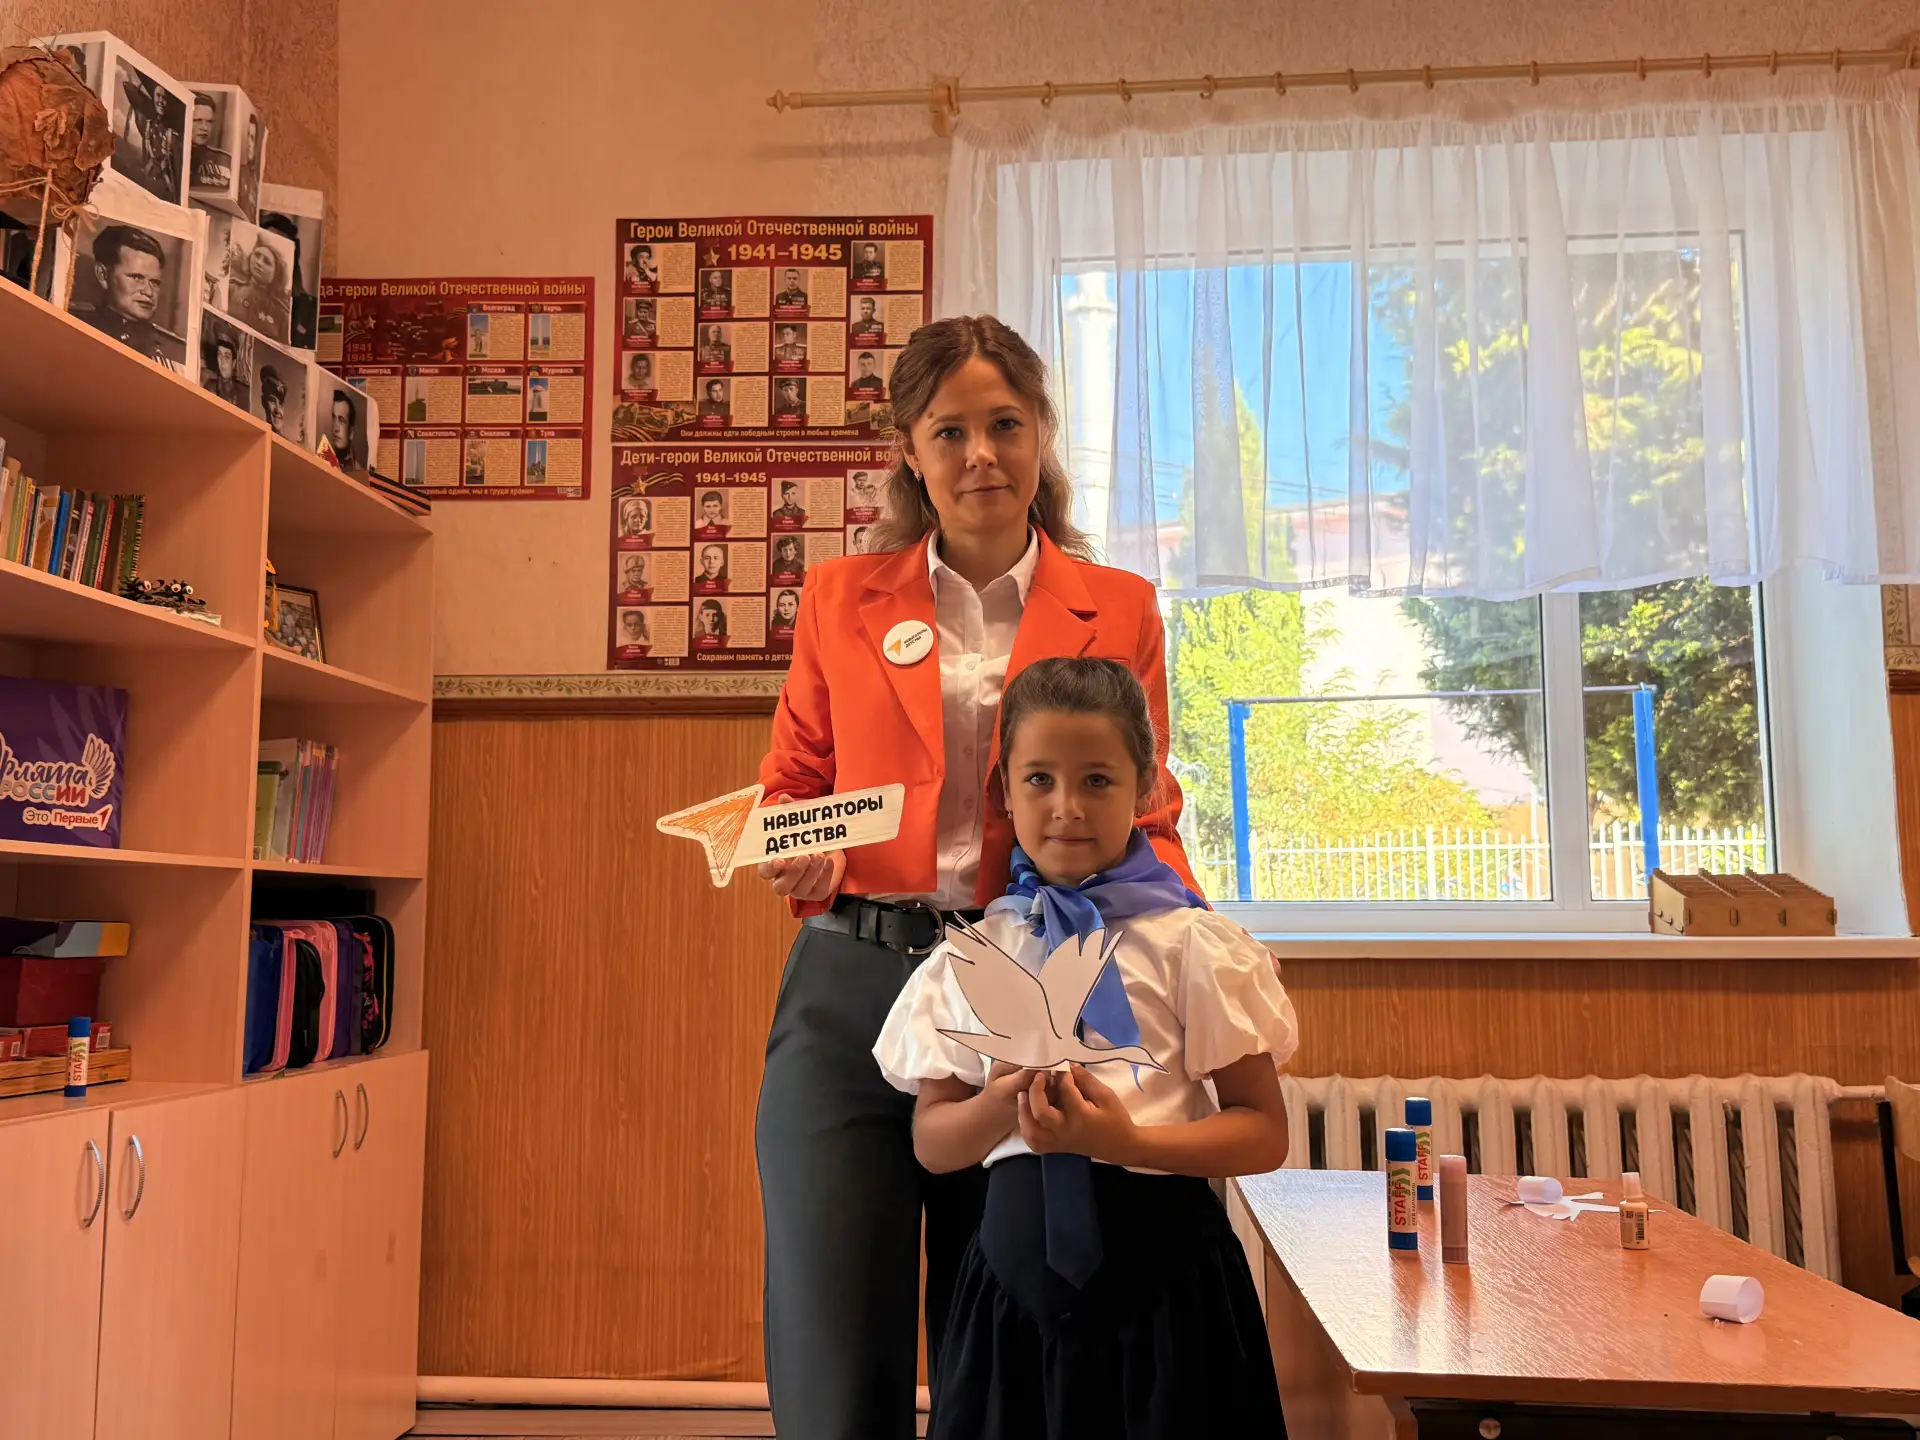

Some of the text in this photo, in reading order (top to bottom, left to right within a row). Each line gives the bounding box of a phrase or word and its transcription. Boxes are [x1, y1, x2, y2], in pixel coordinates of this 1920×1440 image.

[630, 218, 919, 242] Герои Великой Отечественной войны
[320, 281, 586, 299] да-герои Великой Отечественной войны
[346, 343, 372, 352] 1941
[346, 353, 374, 362] 1945
[542, 367, 574, 376] Мурманск
[540, 430, 556, 438] Тула
[694, 430, 722, 438] должны
[724, 430, 740, 438] идти
[740, 428, 775, 437] победным
[776, 429, 799, 438] строем
[806, 428, 830, 437] любые
[831, 429, 859, 438] времена
[620, 450, 700, 466] Дети-герои
[704, 448, 762, 464] Великой
[766, 447, 871, 463] Отечественной
[696, 652, 734, 662] Сохраним
[736, 654, 764, 662] память
[0, 750, 88, 788] рлята
[26, 810, 98, 826] Это Первые
[763, 794, 884, 832] НАВИГАТОРЫ
[765, 823, 848, 856] ДЕТСТВА
[1418, 1143, 1428, 1181] STAFF
[1394, 1181, 1406, 1226] STAFF
